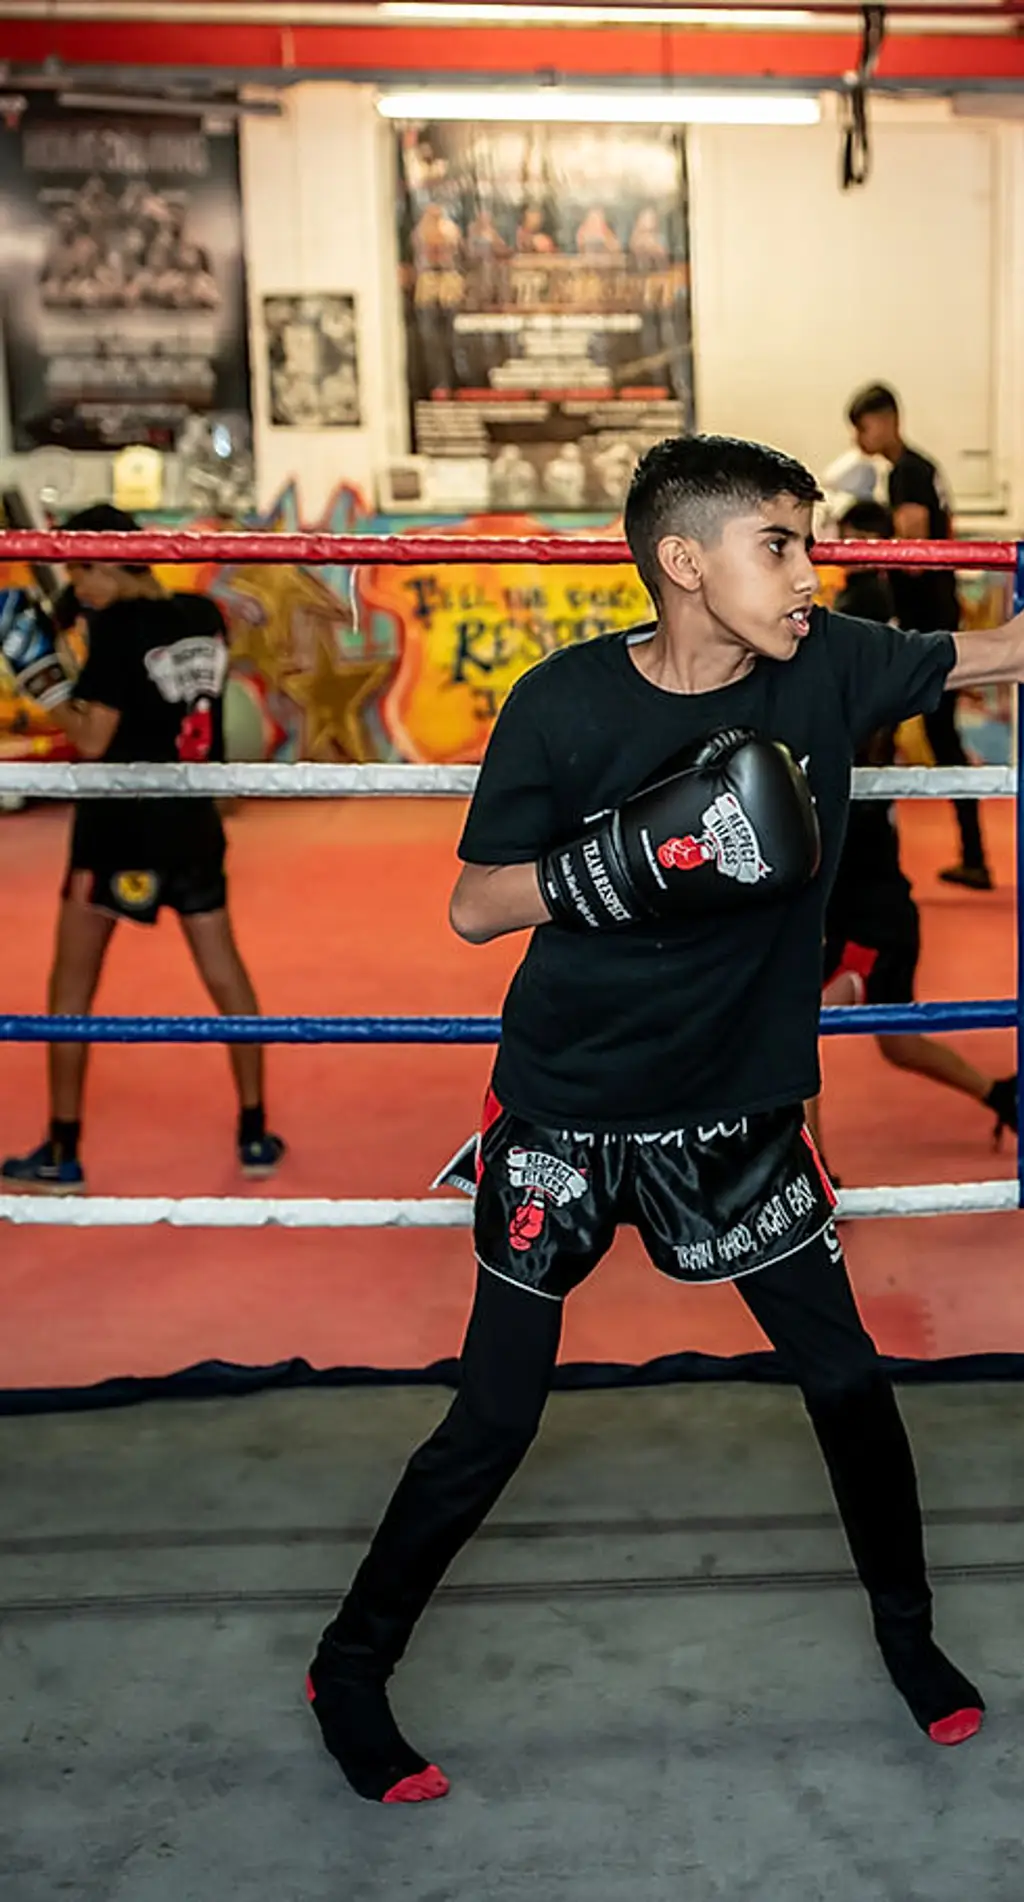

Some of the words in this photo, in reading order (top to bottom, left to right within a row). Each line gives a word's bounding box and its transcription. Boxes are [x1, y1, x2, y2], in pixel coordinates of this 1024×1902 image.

[582, 839, 606, 878] TEAM
[728, 812, 755, 864] RESPECT
[593, 876, 631, 920] RESPECT
[527, 1153, 576, 1182] RESPECT
[673, 1239, 715, 1271] TRAIN
[755, 1195, 793, 1244] FIGHT
[785, 1173, 817, 1218] EASY
